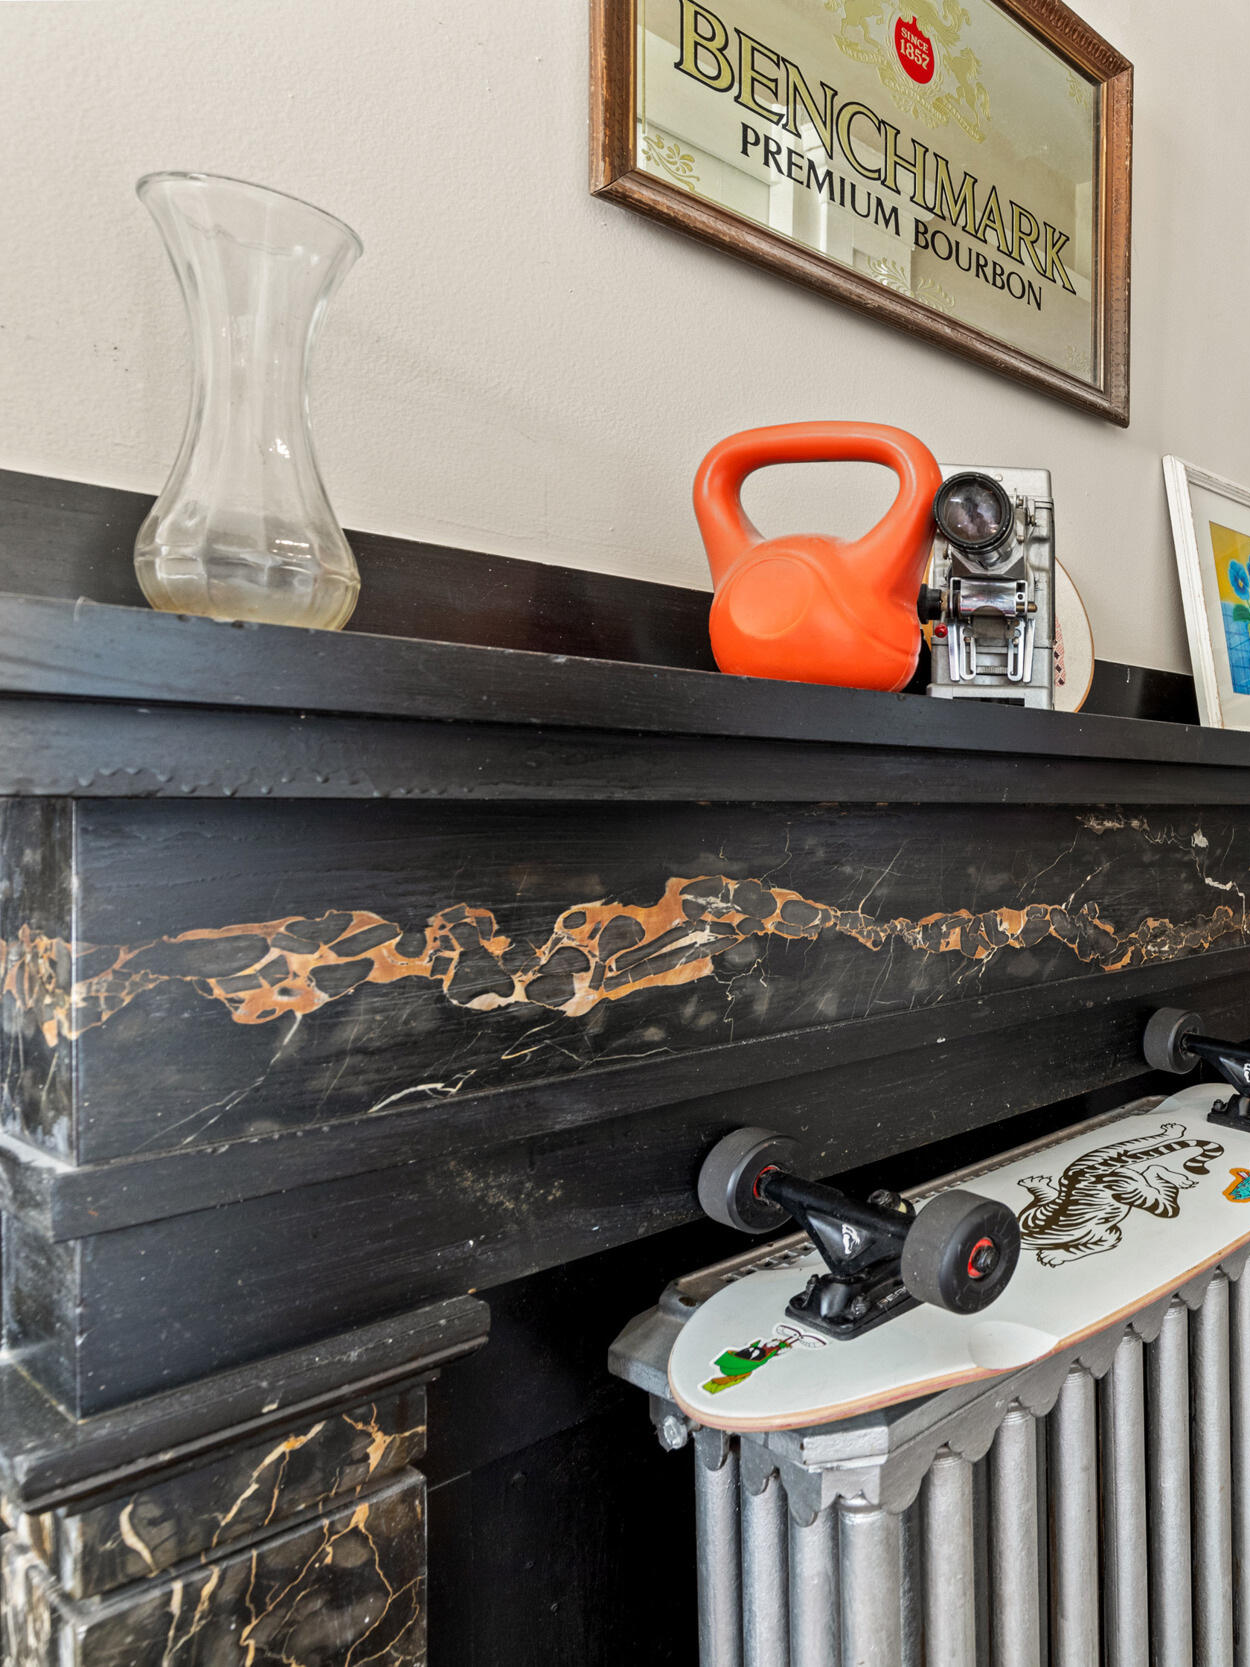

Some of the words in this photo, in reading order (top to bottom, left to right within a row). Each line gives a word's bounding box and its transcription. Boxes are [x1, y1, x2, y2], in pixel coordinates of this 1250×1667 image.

[899, 39, 930, 70] 1857
[900, 27, 929, 54] SINCE
[673, 0, 1077, 296] BENCHMARK
[739, 122, 901, 237] PREMIUM
[912, 218, 1043, 311] BOURBON
